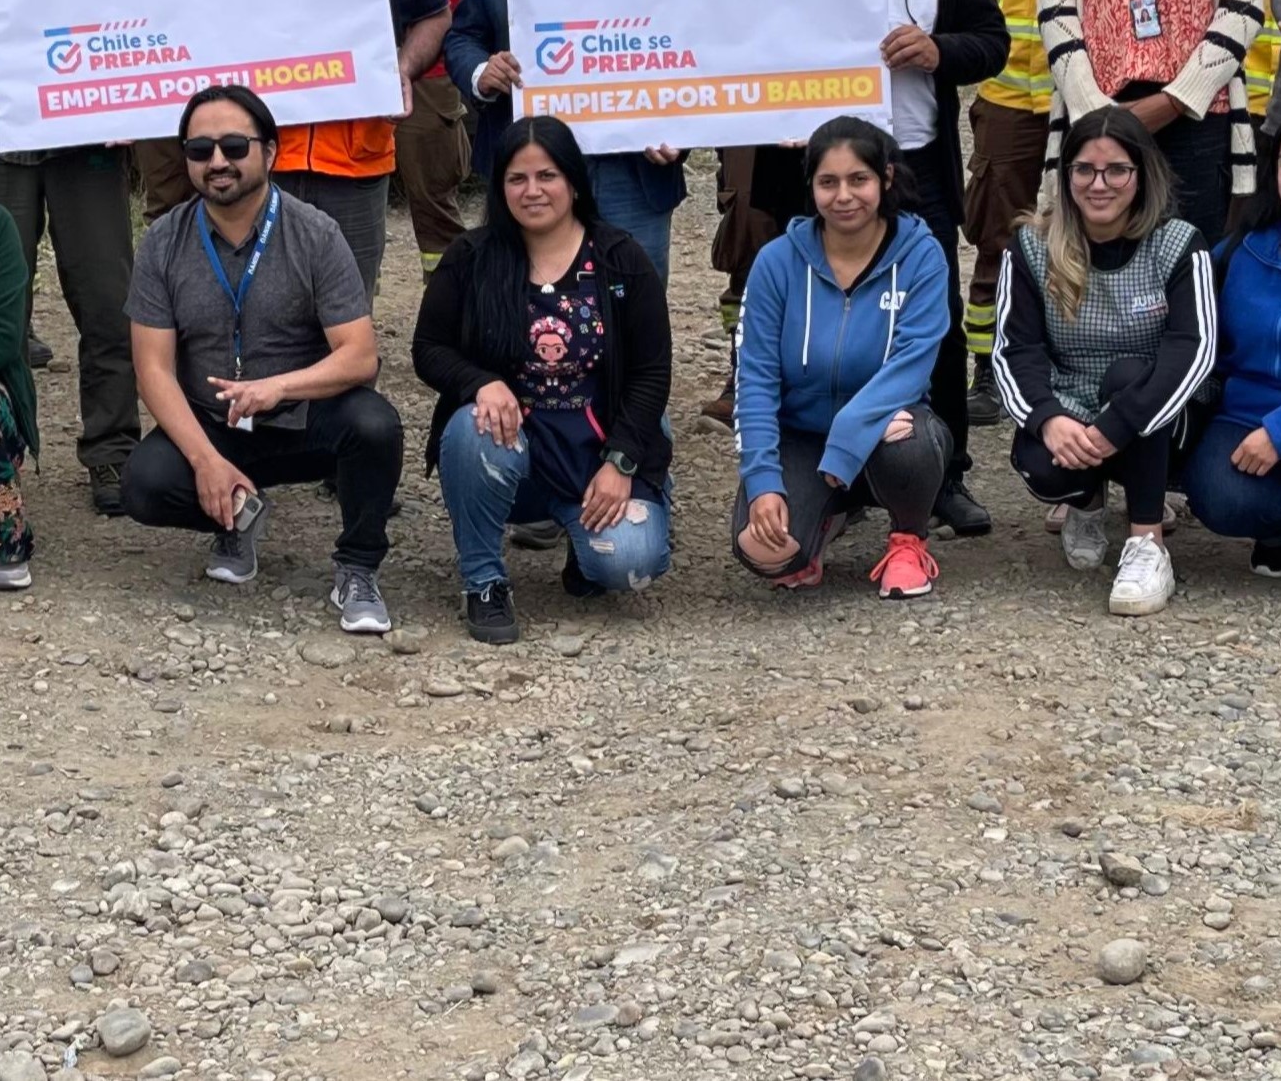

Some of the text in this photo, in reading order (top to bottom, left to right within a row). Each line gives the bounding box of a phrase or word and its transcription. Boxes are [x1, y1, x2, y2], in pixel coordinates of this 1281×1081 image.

[87, 33, 168, 53] Chile se
[581, 33, 672, 53] Chile se
[89, 45, 192, 71] PREPARA
[582, 49, 697, 74] PREPARA
[46, 59, 345, 111] EMPIEZA POR TU HOGAR
[531, 75, 874, 116] EMPIEZA POR TU BARRIO
